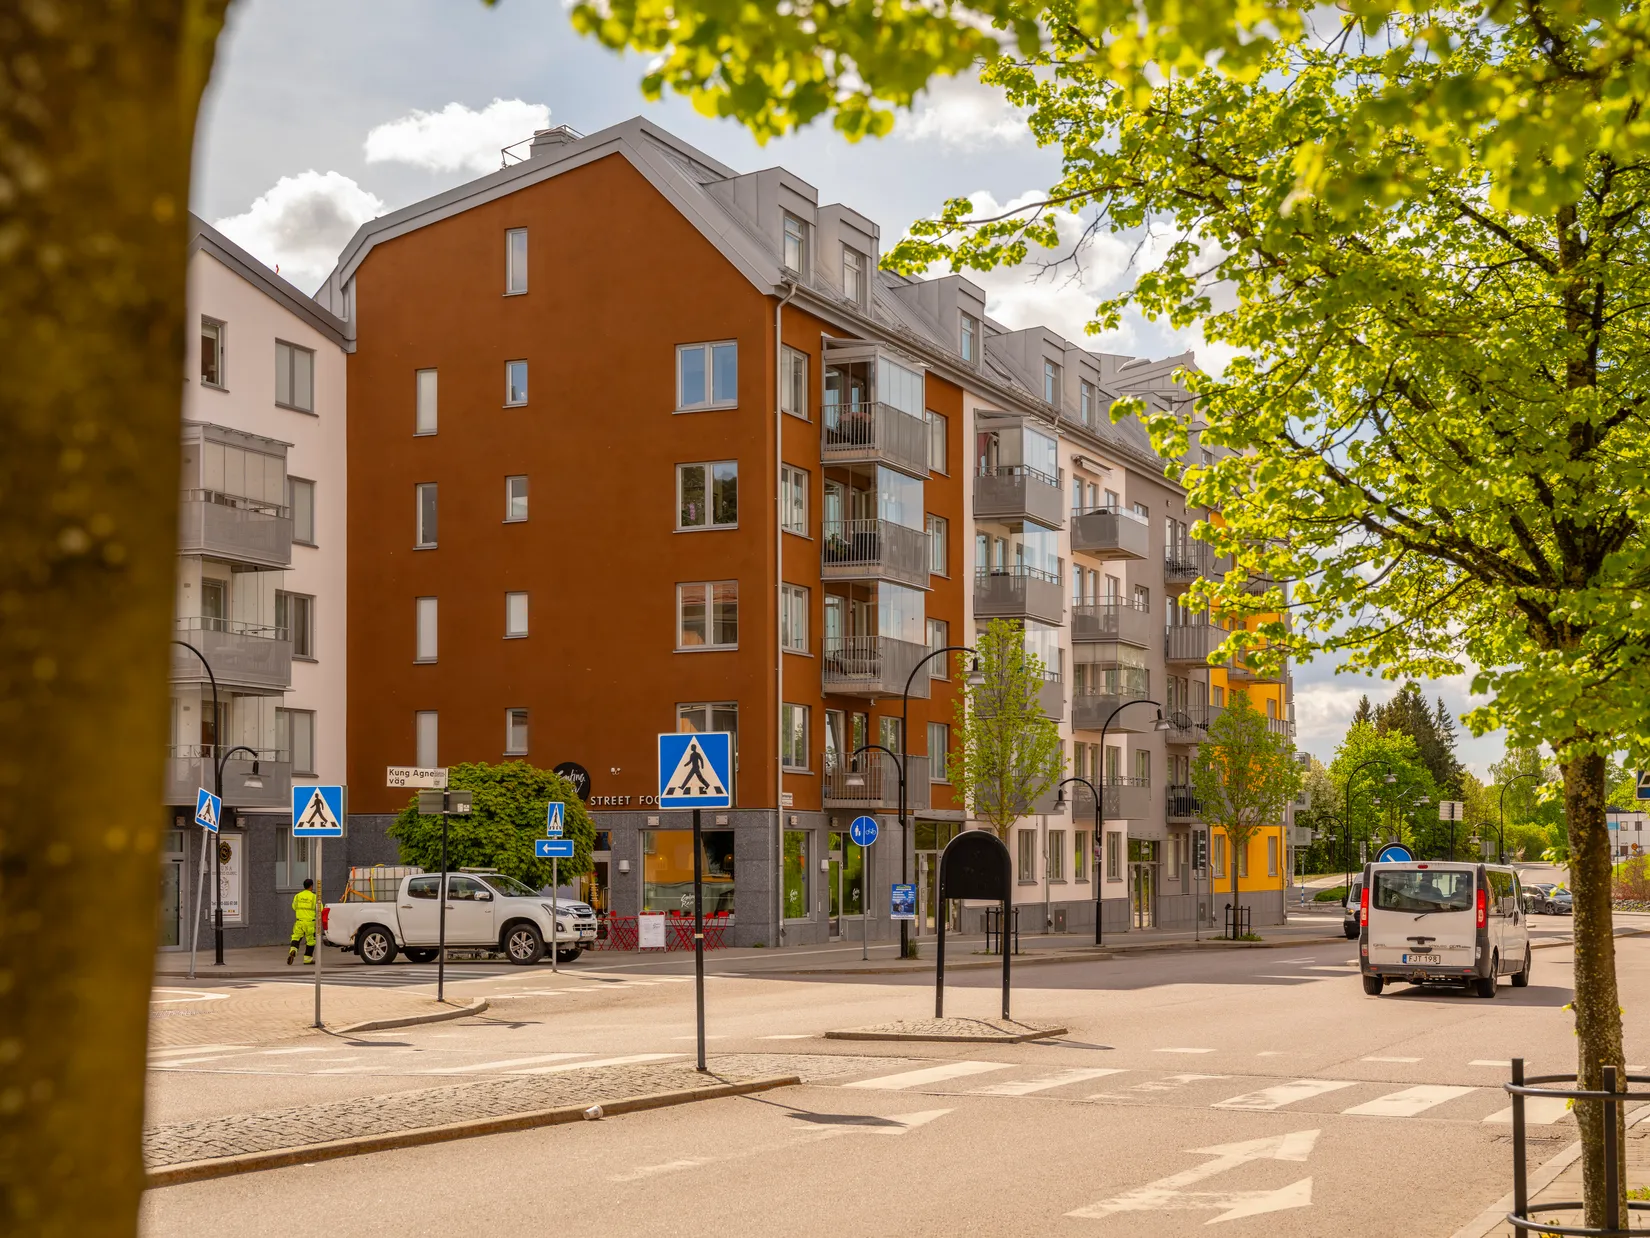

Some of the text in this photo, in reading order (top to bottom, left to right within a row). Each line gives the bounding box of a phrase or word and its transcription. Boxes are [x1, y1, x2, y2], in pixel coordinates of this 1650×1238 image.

[389, 768, 410, 778] Kung
[413, 769, 435, 778] Agne
[389, 777, 405, 786] väg
[590, 795, 659, 806] STREET FOO
[1424, 955, 1437, 963] 198
